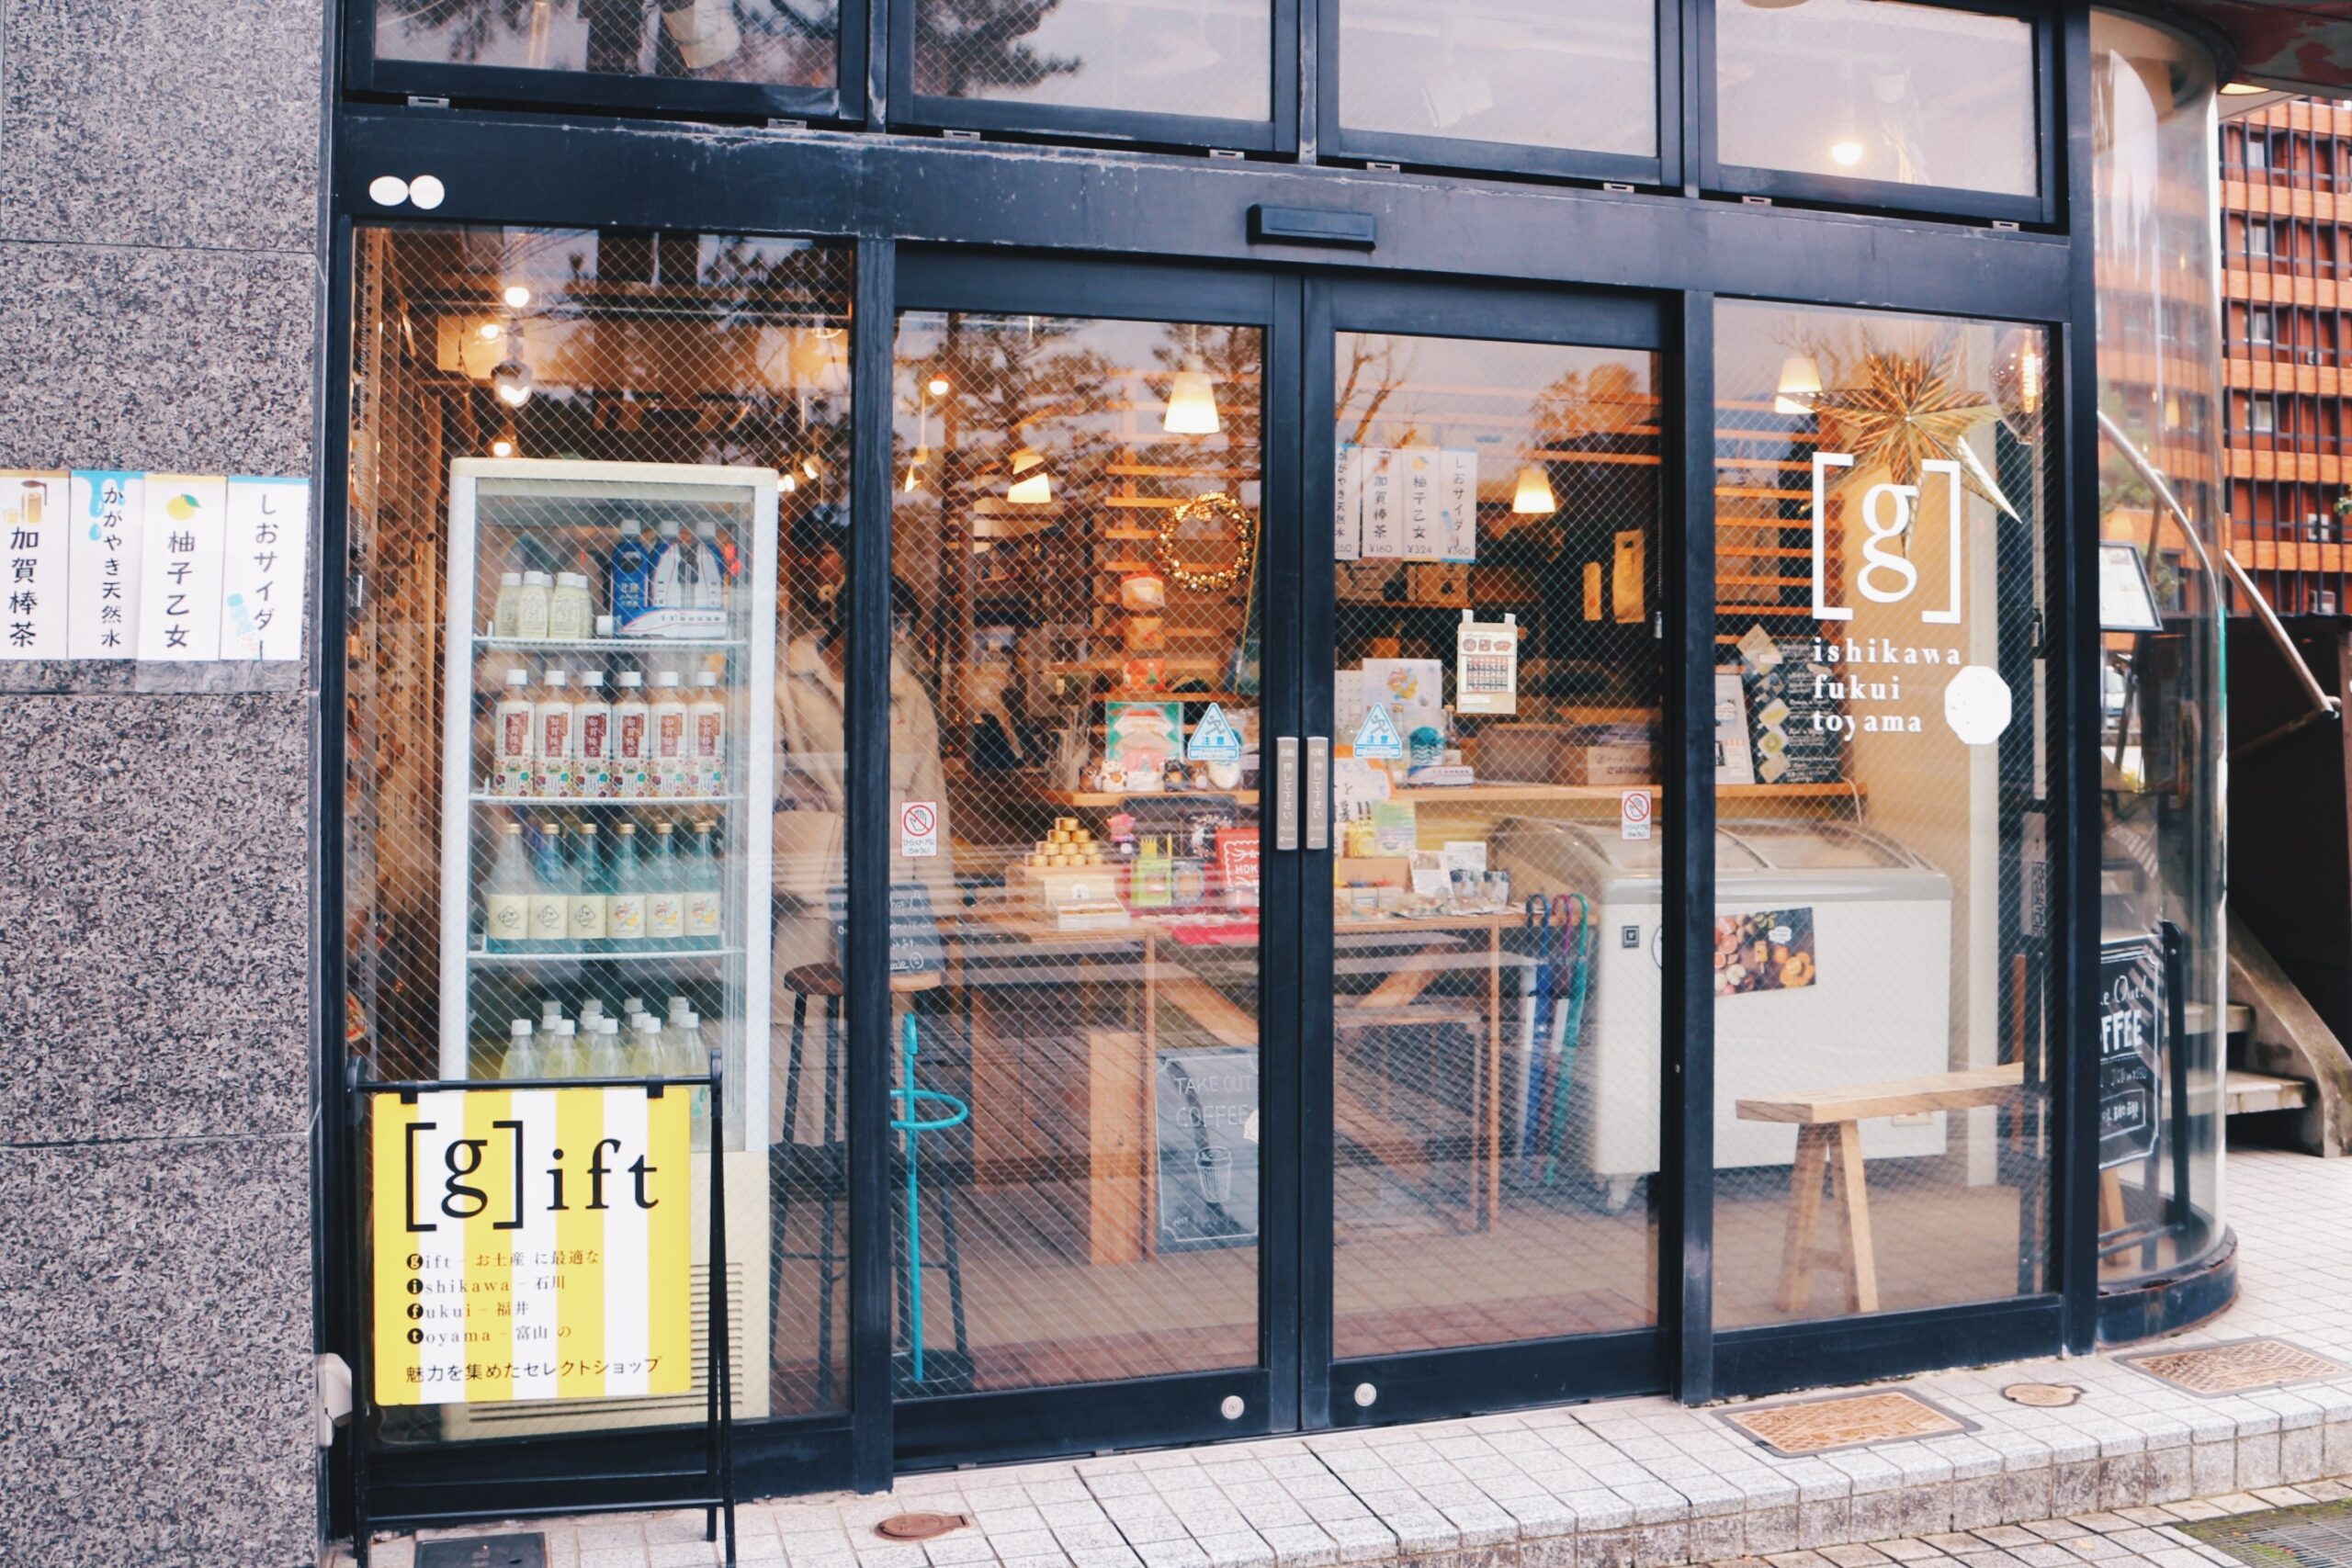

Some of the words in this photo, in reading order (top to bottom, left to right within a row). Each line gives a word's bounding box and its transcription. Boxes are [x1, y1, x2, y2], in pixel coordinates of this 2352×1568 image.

[1413, 476, 1427, 539] 柚子乙女
[1453, 457, 1465, 547] しおサイダー
[100, 487, 124, 648] かがやき天然水
[254, 493, 278, 661] しおサイダー
[9, 526, 39, 648] 加賀棒茶
[164, 529, 195, 649] 柚子乙女
[1814, 637, 1961, 666] ishikawa
[1814, 674, 1900, 700] fukui
[1813, 714, 1922, 741] toyama
[1174, 1076, 1219, 1096] TAKE
[1223, 1075, 1255, 1092] OUT
[1176, 1104, 1248, 1129] COFFEE
[405, 1121, 660, 1232] [g]ift
[406, 1253, 451, 1271] gift
[475, 1252, 525, 1267] お土産
[534, 1250, 599, 1266] に最適な
[406, 1278, 510, 1295] ishikawa
[535, 1276, 566, 1292] 石川
[406, 1302, 472, 1320] fukui
[496, 1302, 529, 1317] 福井
[406, 1327, 491, 1347] toyama
[515, 1325, 548, 1340] 富山
[557, 1326, 571, 1339] の
[405, 1355, 662, 1384] 魅力を集めたセレクトショップ
